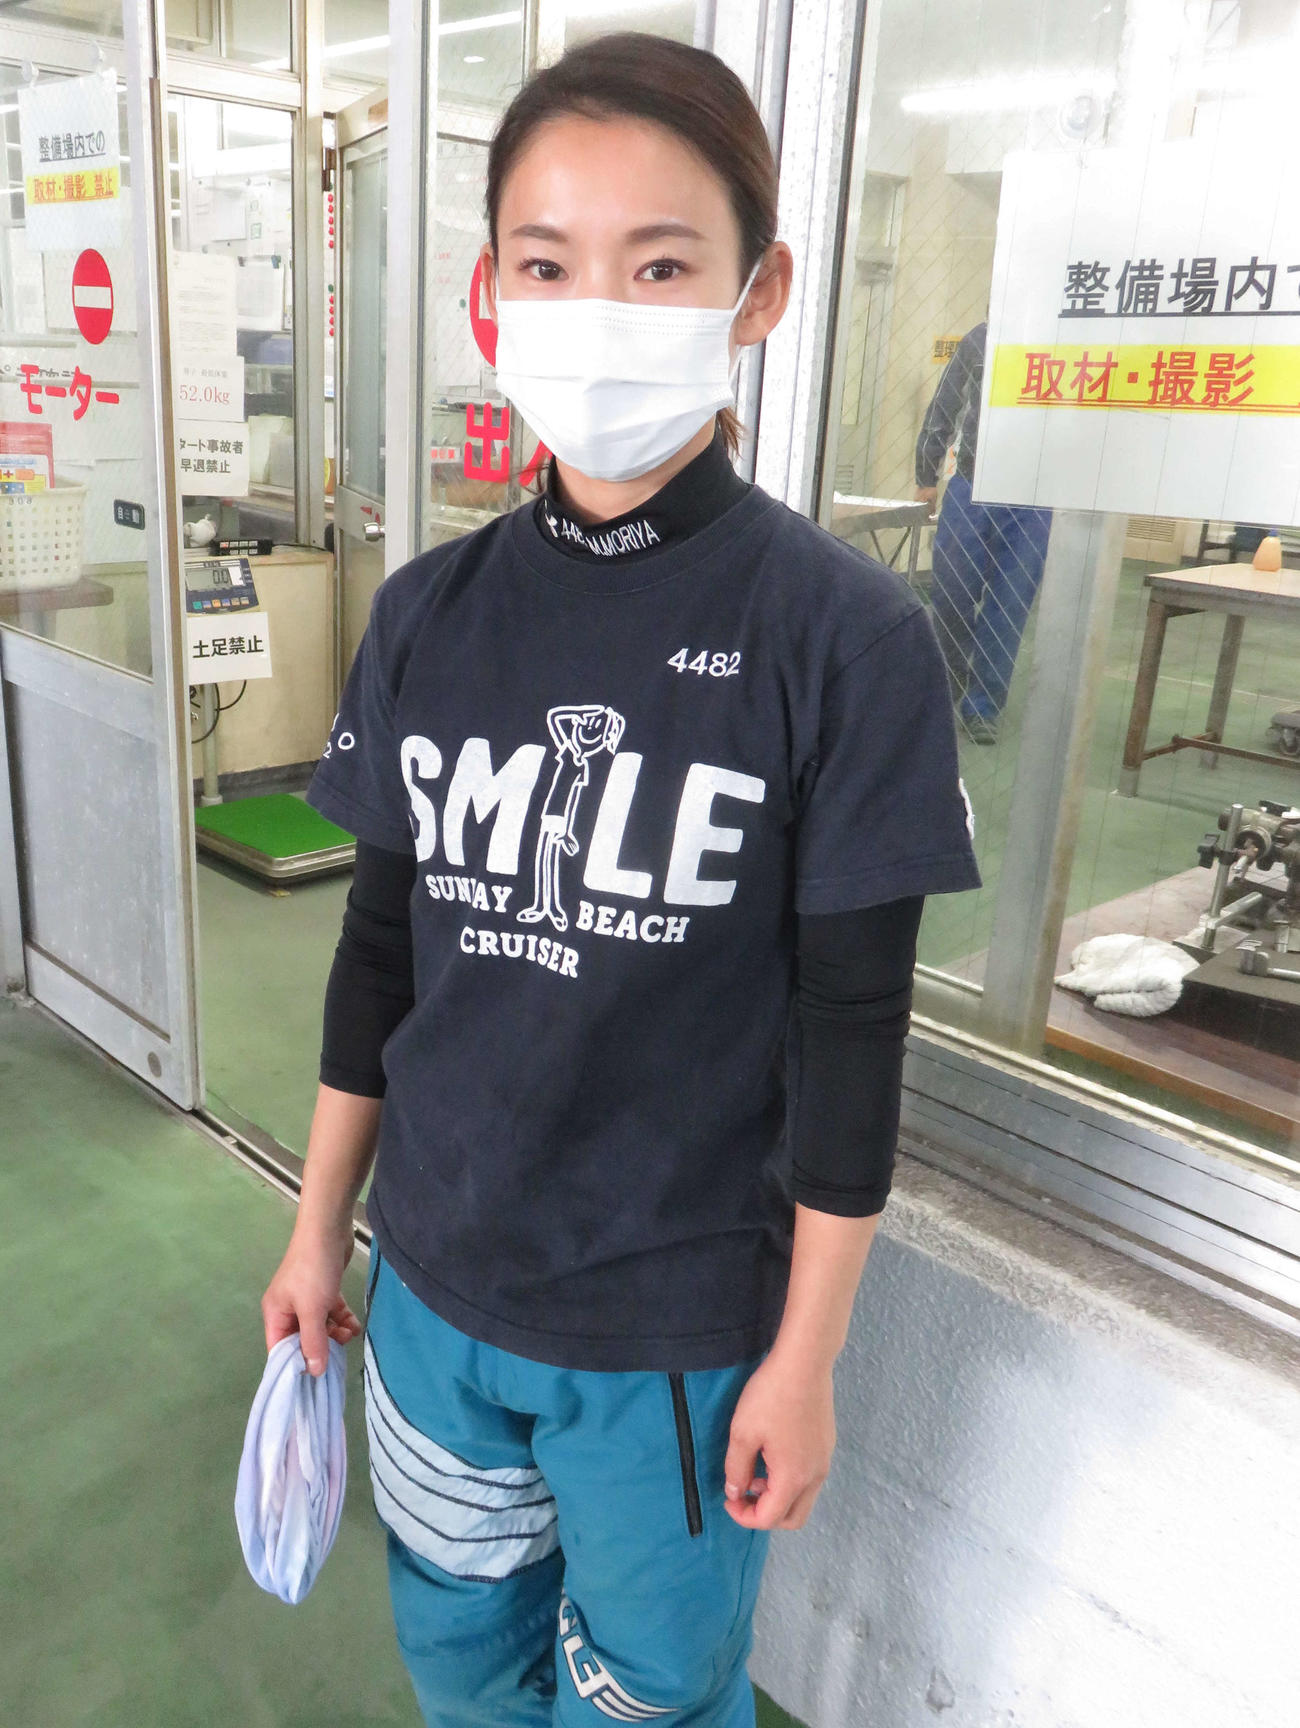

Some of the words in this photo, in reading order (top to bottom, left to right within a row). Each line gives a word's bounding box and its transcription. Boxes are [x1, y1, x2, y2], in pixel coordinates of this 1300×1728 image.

[38, 130, 105, 160] 整備場内での
[20, 363, 119, 421] モーター
[179, 384, 231, 405] 52.0kg
[1020, 351, 1255, 408] 取材・撮影
[180, 458, 231, 473] 早退禁止
[192, 635, 265, 659] 土足禁止
[667, 647, 741, 677] 4482
[425, 874, 513, 914] SUNAY
[575, 900, 690, 944] BEACH
[459, 926, 580, 978] CRUISER
